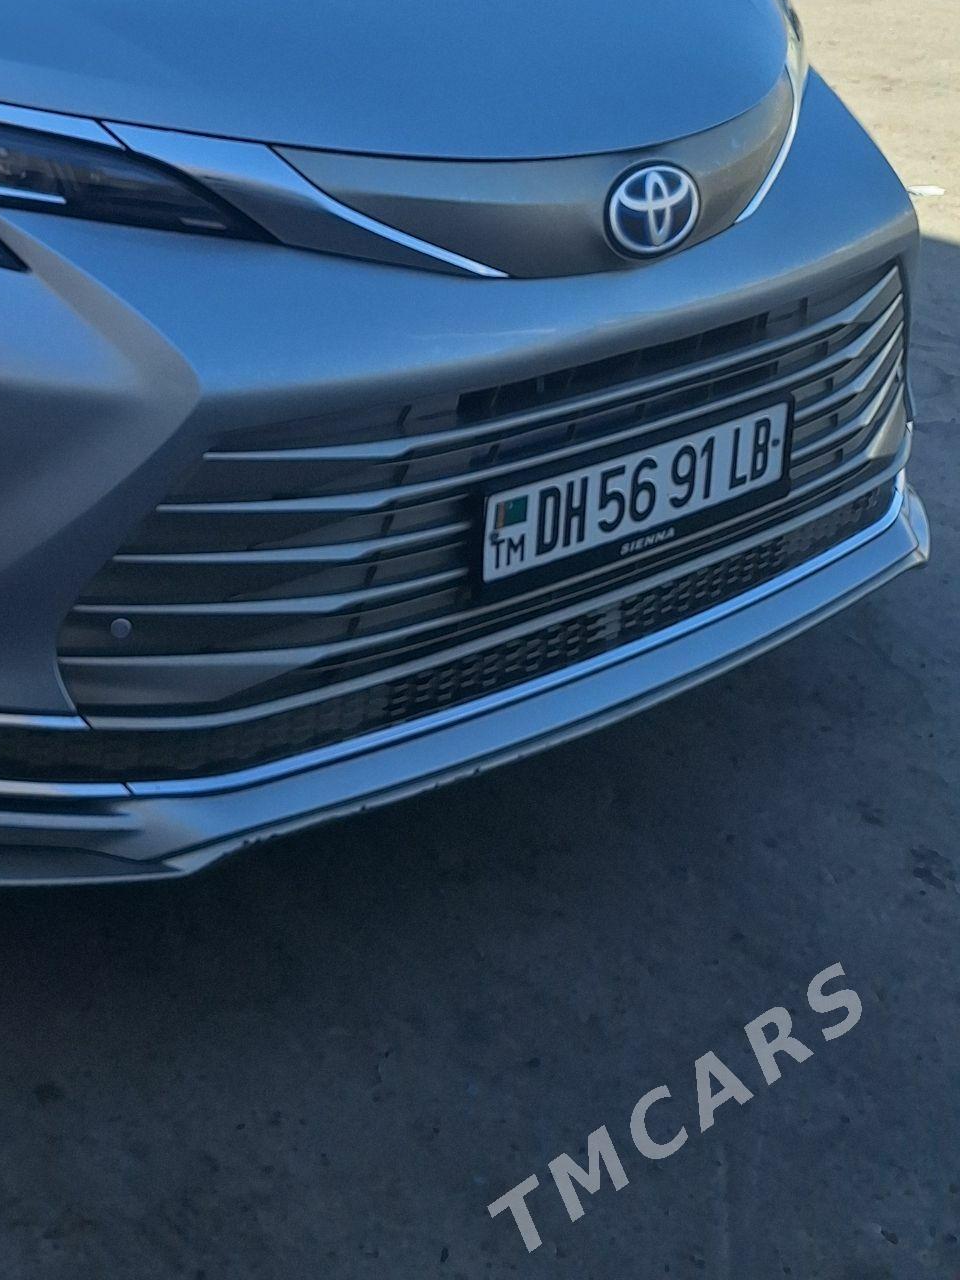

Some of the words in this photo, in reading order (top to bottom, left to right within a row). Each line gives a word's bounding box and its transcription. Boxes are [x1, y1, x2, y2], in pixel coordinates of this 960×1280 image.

[535, 476, 589, 556] DH
[598, 457, 658, 534] 56
[669, 436, 716, 508] 91
[729, 417, 771, 490] LB
[491, 533, 526, 569] TM
[619, 526, 676, 556] SIENNA
